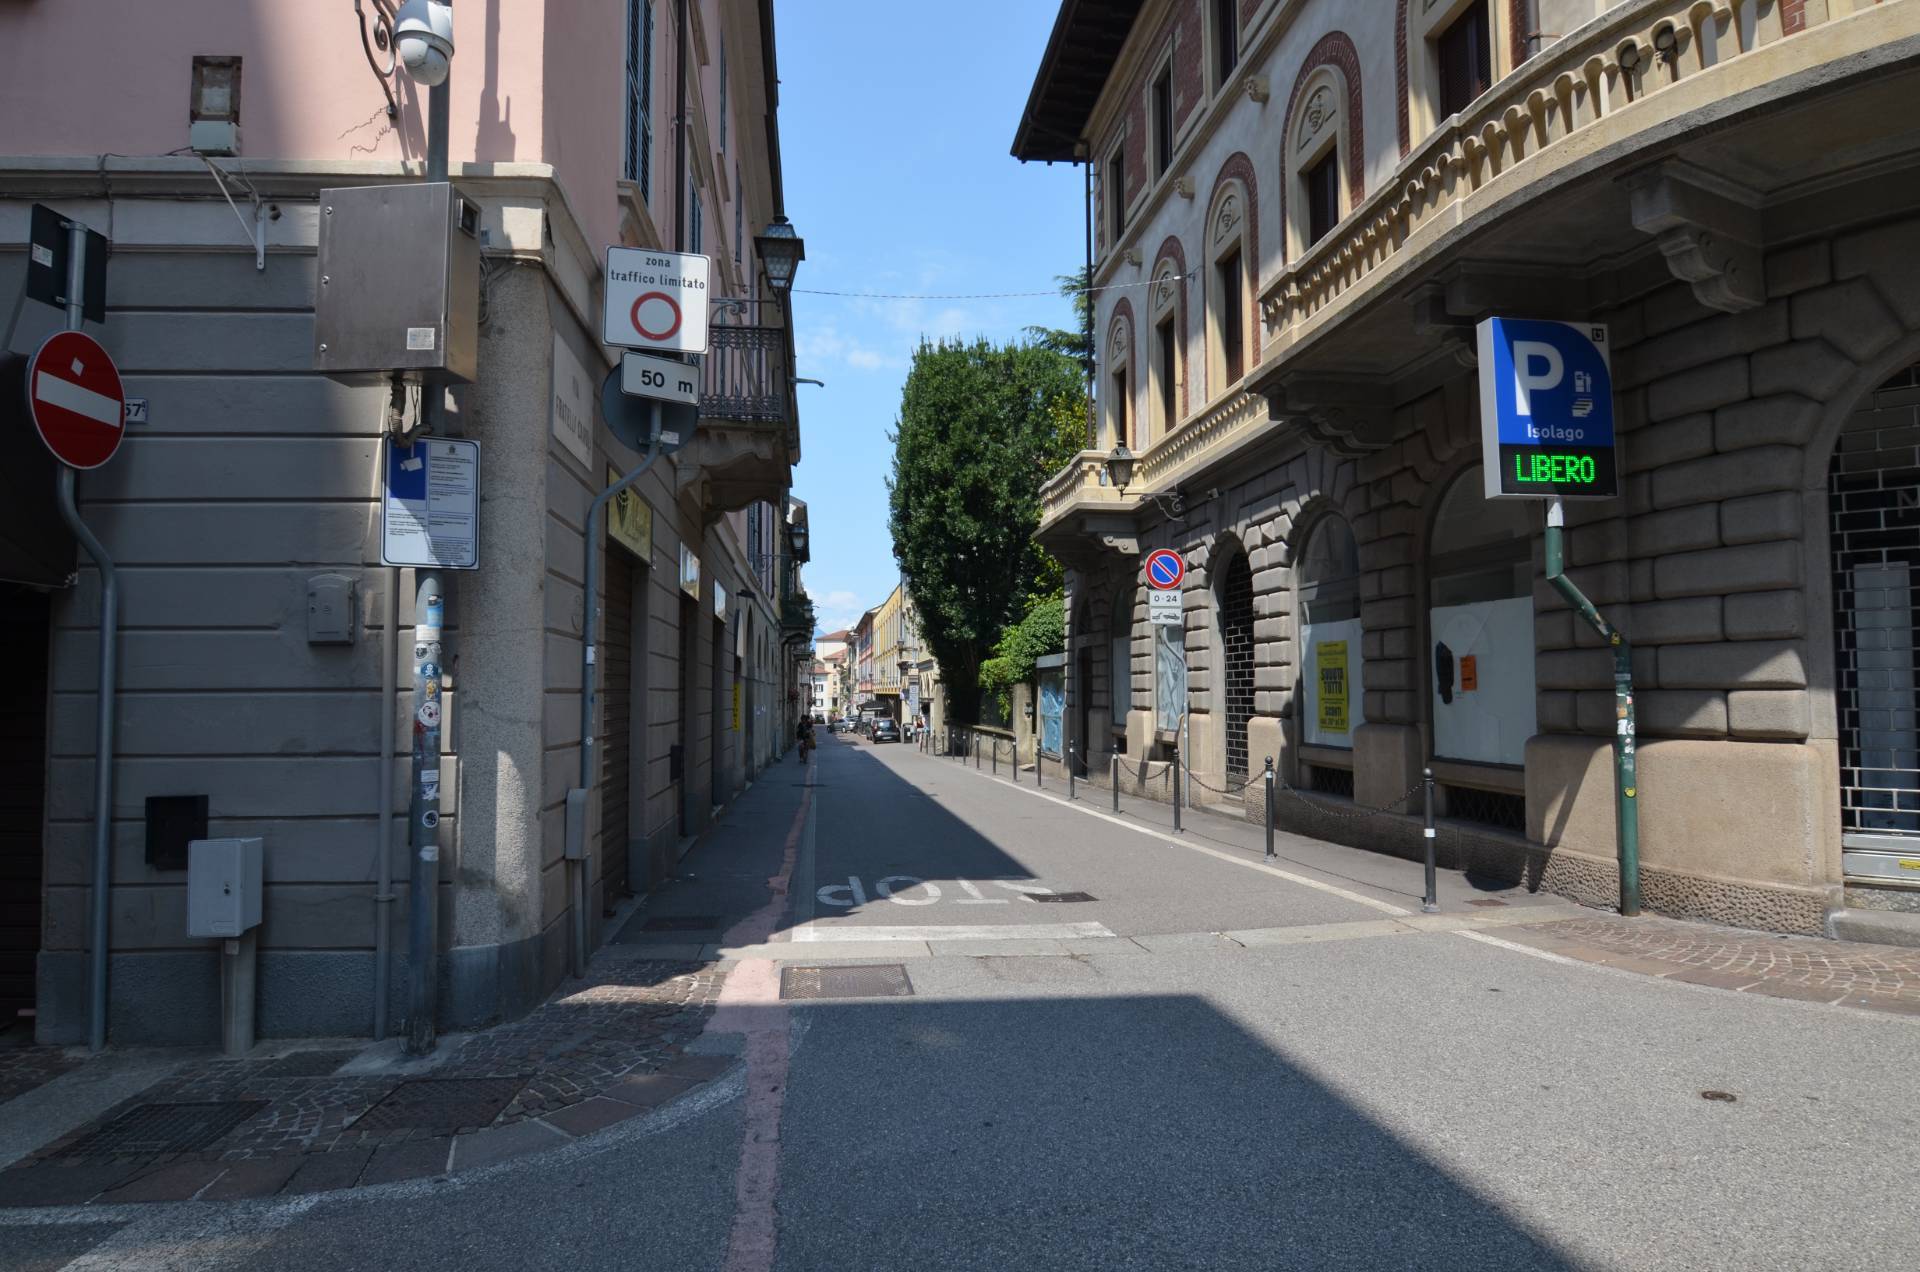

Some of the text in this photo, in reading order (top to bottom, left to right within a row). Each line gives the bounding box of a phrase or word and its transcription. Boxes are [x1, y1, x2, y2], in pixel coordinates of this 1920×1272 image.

[645, 256, 671, 268] zona
[610, 269, 705, 290] traffico limitato
[641, 370, 693, 394] 50 m
[1513, 340, 1564, 416] P
[1527, 423, 1585, 441] Isolago
[1514, 453, 1596, 484] LIBERO
[1323, 681, 1343, 695] TUTTO
[816, 875, 1058, 906] STOP
